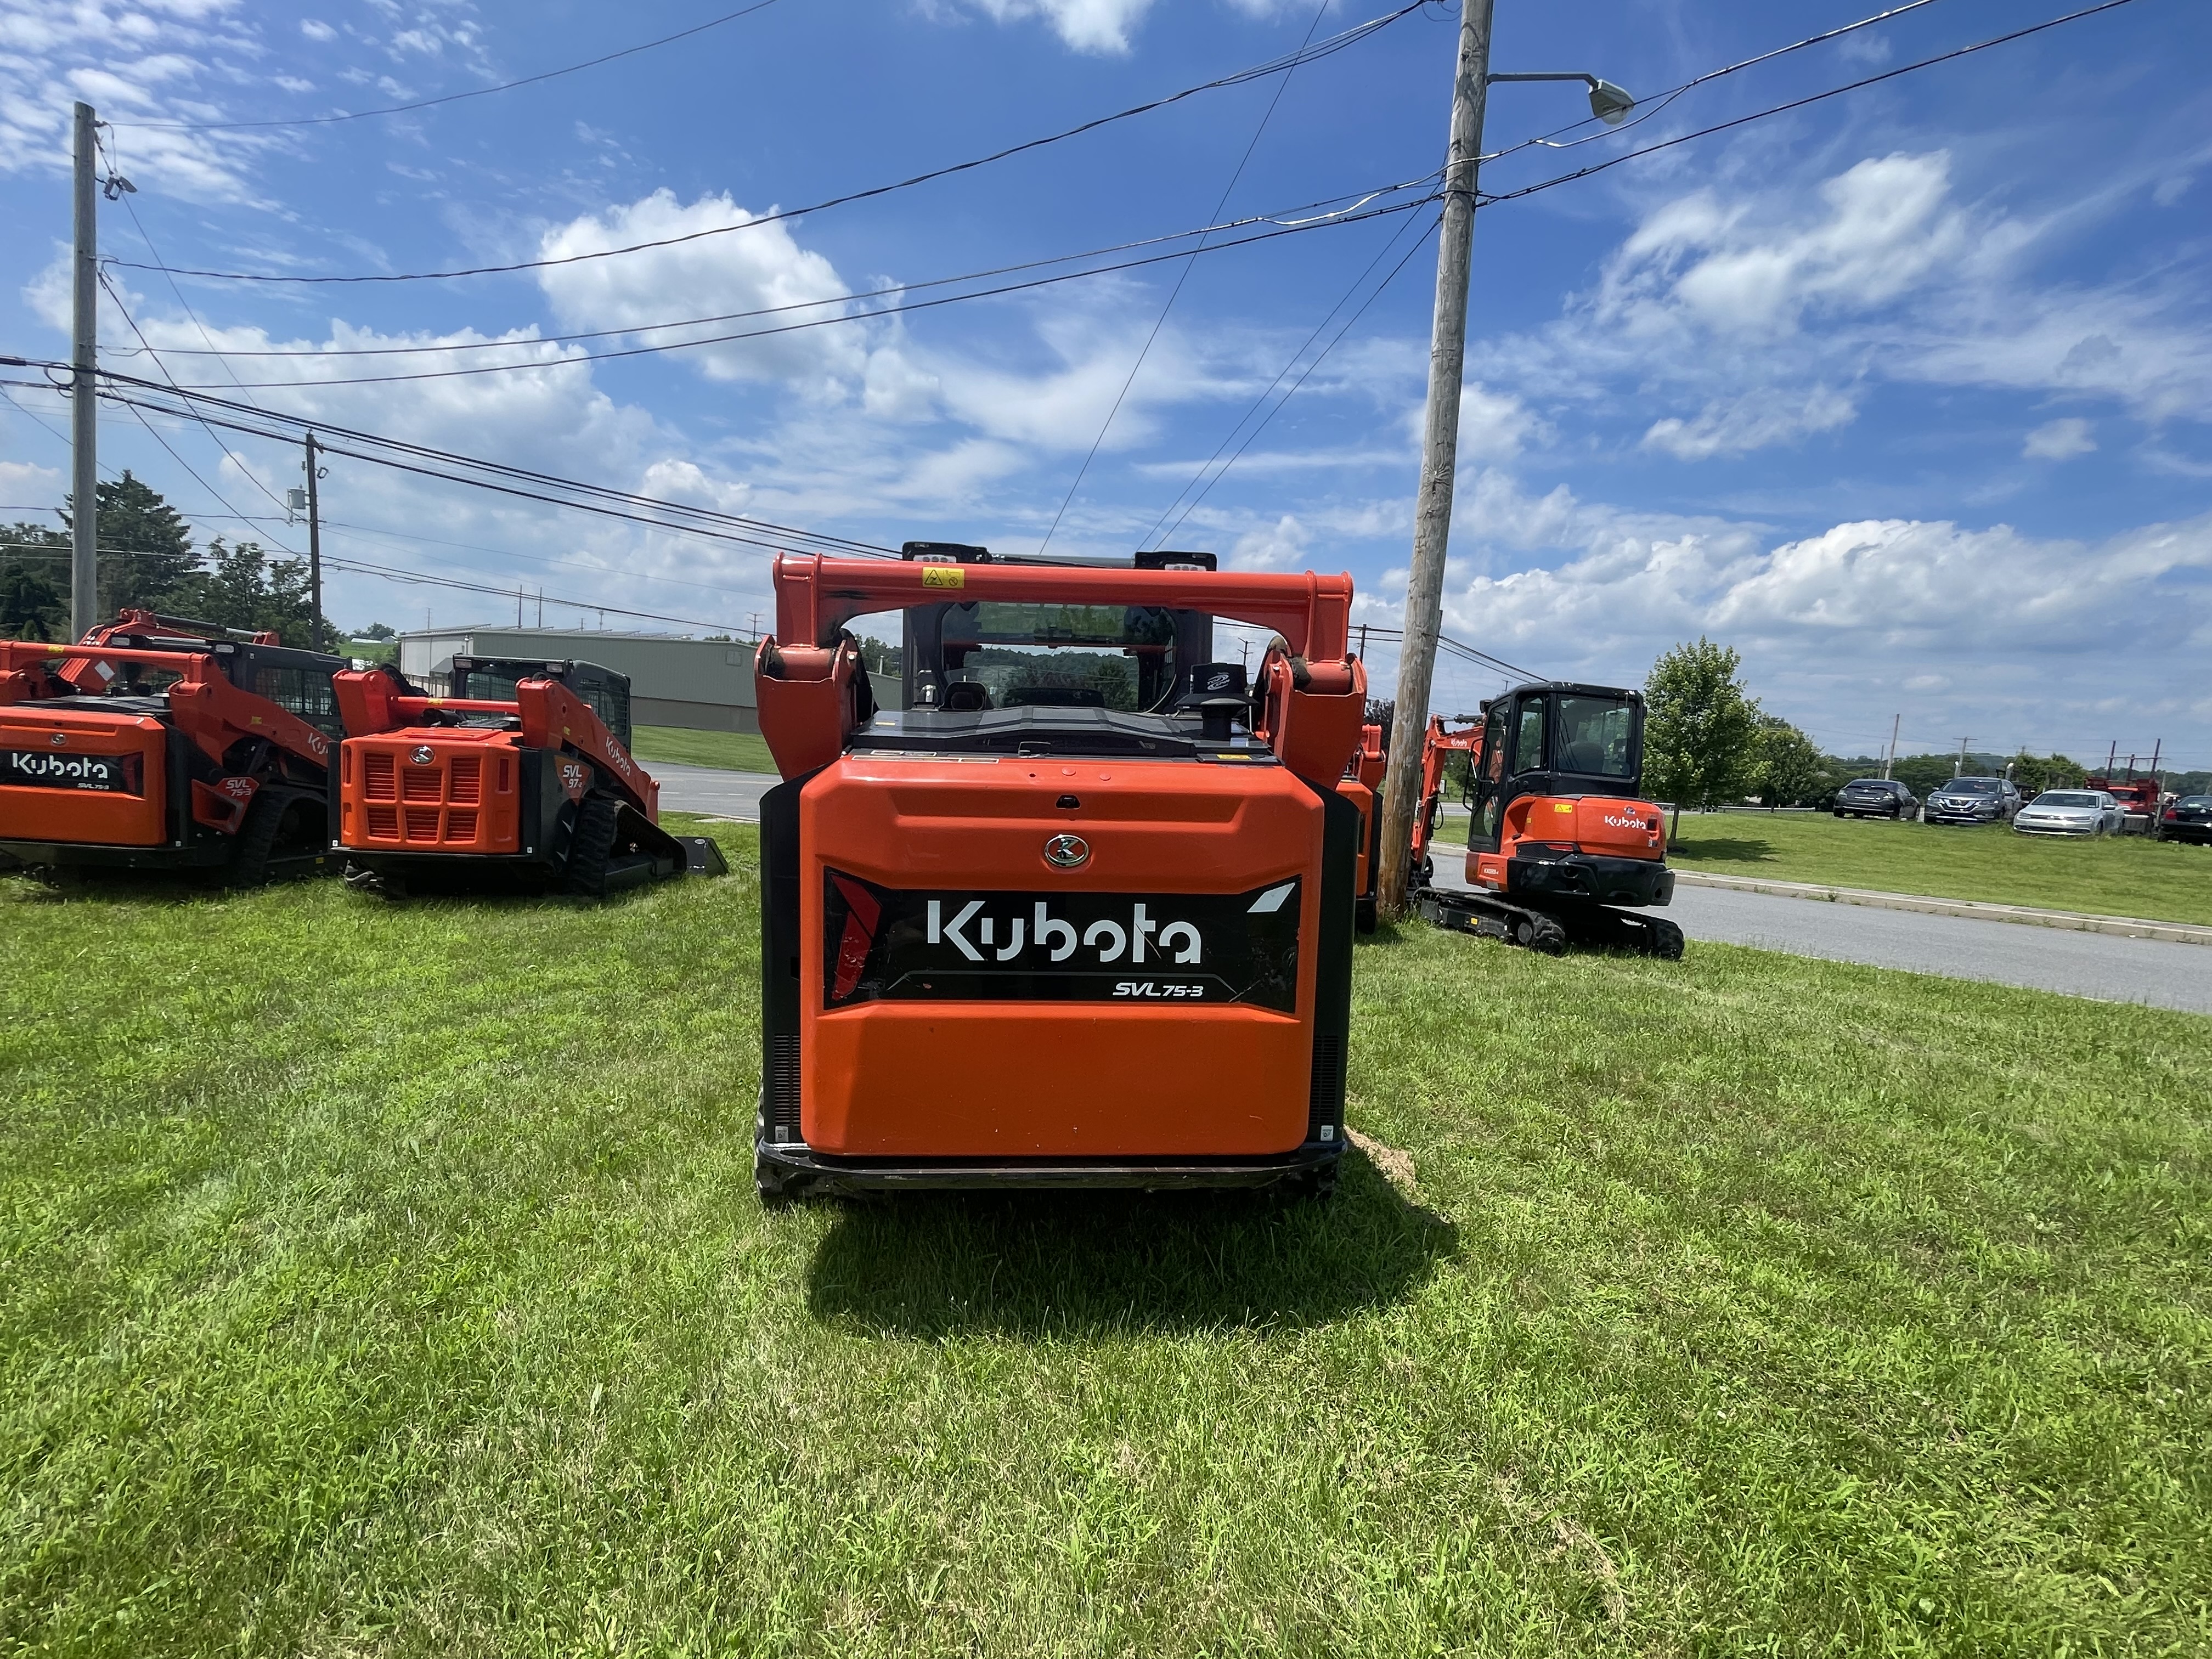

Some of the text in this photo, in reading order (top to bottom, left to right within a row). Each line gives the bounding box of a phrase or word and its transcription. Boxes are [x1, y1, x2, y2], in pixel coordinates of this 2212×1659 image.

[12, 753, 108, 779] Kubota
[606, 736, 630, 776] Kubota
[562, 765, 582, 777] SVL
[225, 779, 250, 789] SVL
[1605, 815, 1646, 830] Kubota
[927, 900, 1201, 963] Kubota
